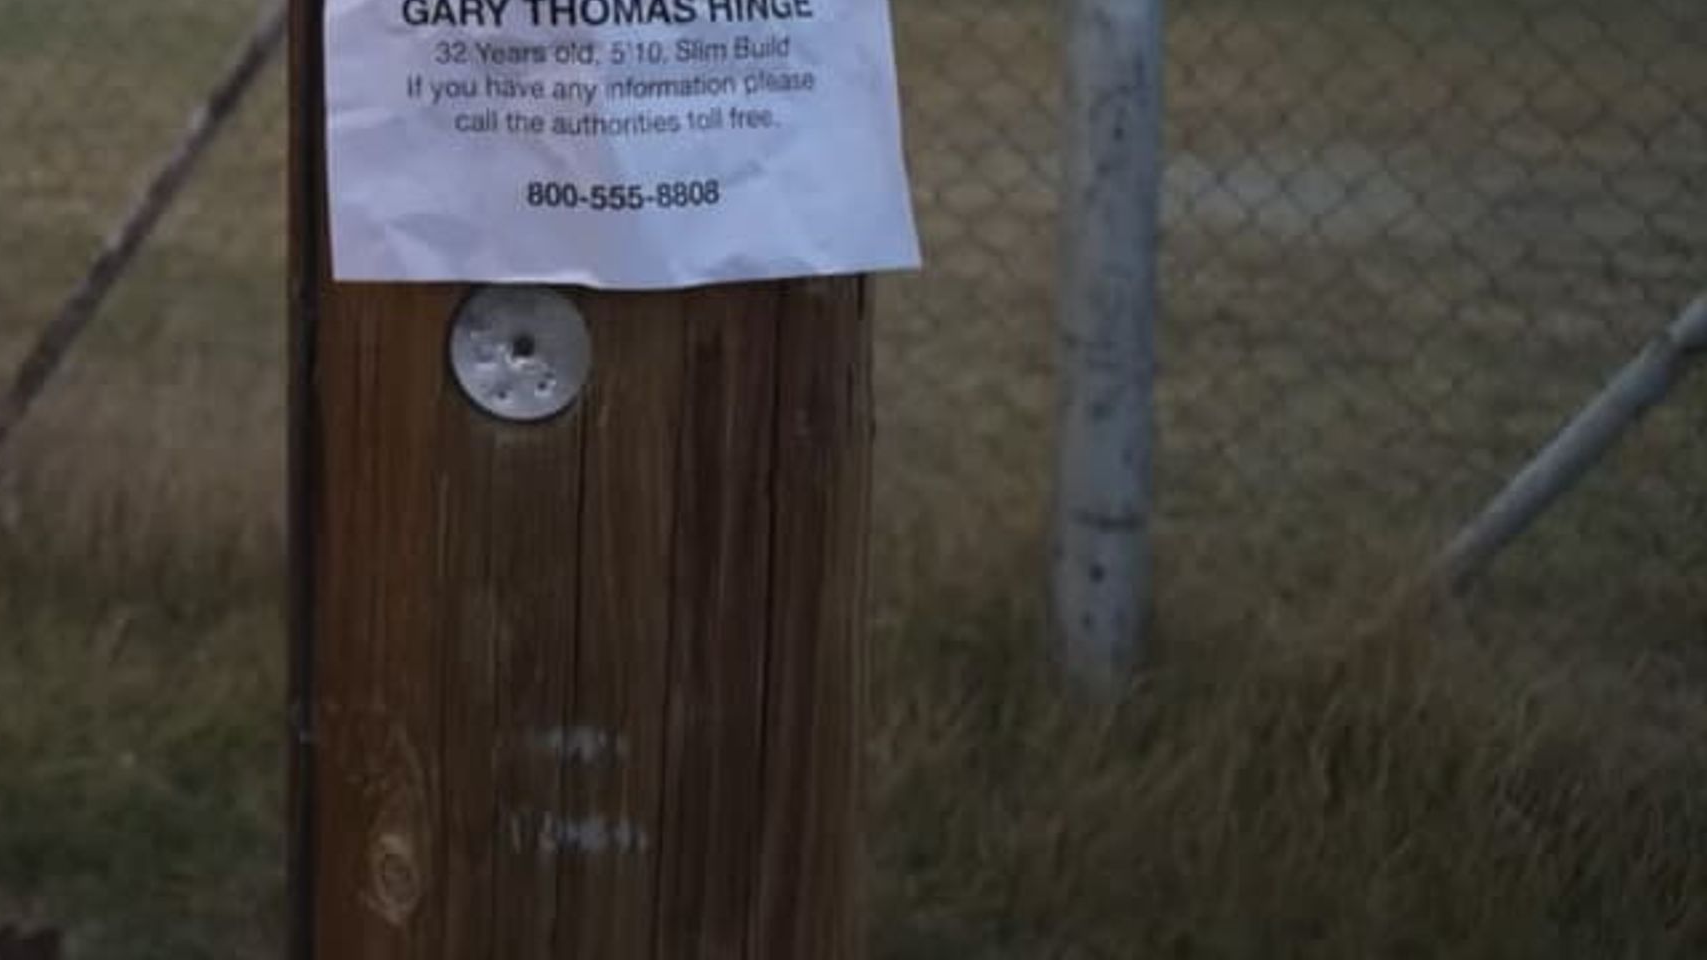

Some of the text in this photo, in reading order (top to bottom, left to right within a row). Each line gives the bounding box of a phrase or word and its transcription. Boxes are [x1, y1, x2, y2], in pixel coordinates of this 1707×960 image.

[435, 42, 467, 64] 32
[475, 42, 546, 65] Years
[676, 39, 727, 62] Slim
[734, 37, 791, 60] Build
[407, 71, 816, 106] If you have any information please
[455, 108, 498, 132] call
[506, 111, 544, 133] the
[552, 110, 681, 136] authorities
[688, 108, 723, 130] toll
[527, 179, 720, 210] 800-555-8808
